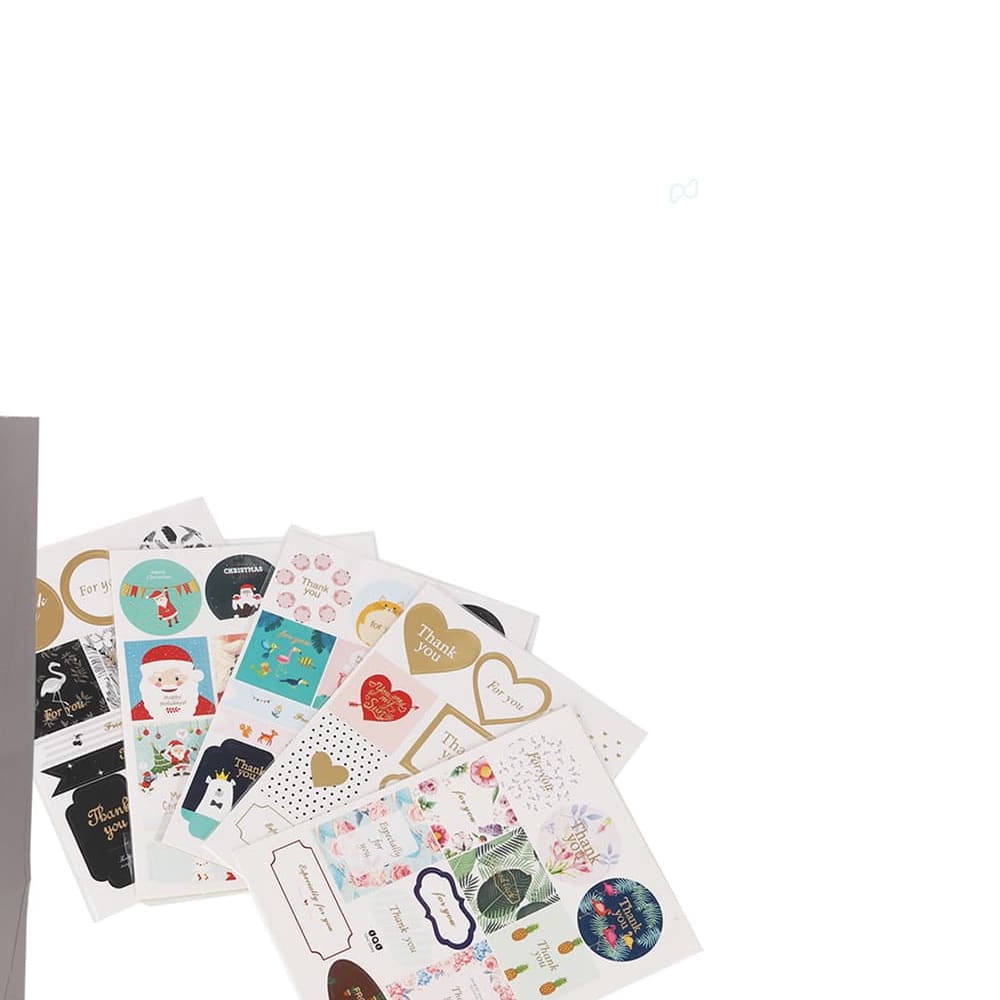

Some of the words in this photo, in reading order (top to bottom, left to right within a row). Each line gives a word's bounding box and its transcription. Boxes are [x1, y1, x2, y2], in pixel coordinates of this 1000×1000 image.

[79, 582, 99, 597] For
[302, 576, 330, 594] Thank
[303, 586, 322, 599] you
[414, 641, 441, 663] you
[417, 623, 458, 659] Thank
[486, 679, 505, 698] For
[502, 693, 525, 712] you
[43, 706, 64, 721] For
[525, 751, 542, 771] For
[87, 796, 130, 827] Thank
[103, 818, 128, 841] you
[571, 815, 602, 865] Thank
[562, 832, 587, 860] you
[611, 908, 629, 930] you
[619, 895, 642, 934] Thank
[389, 903, 409, 934] Thank
[401, 936, 417, 954] you
[531, 950, 547, 969] you
[537, 939, 559, 972] Thank
